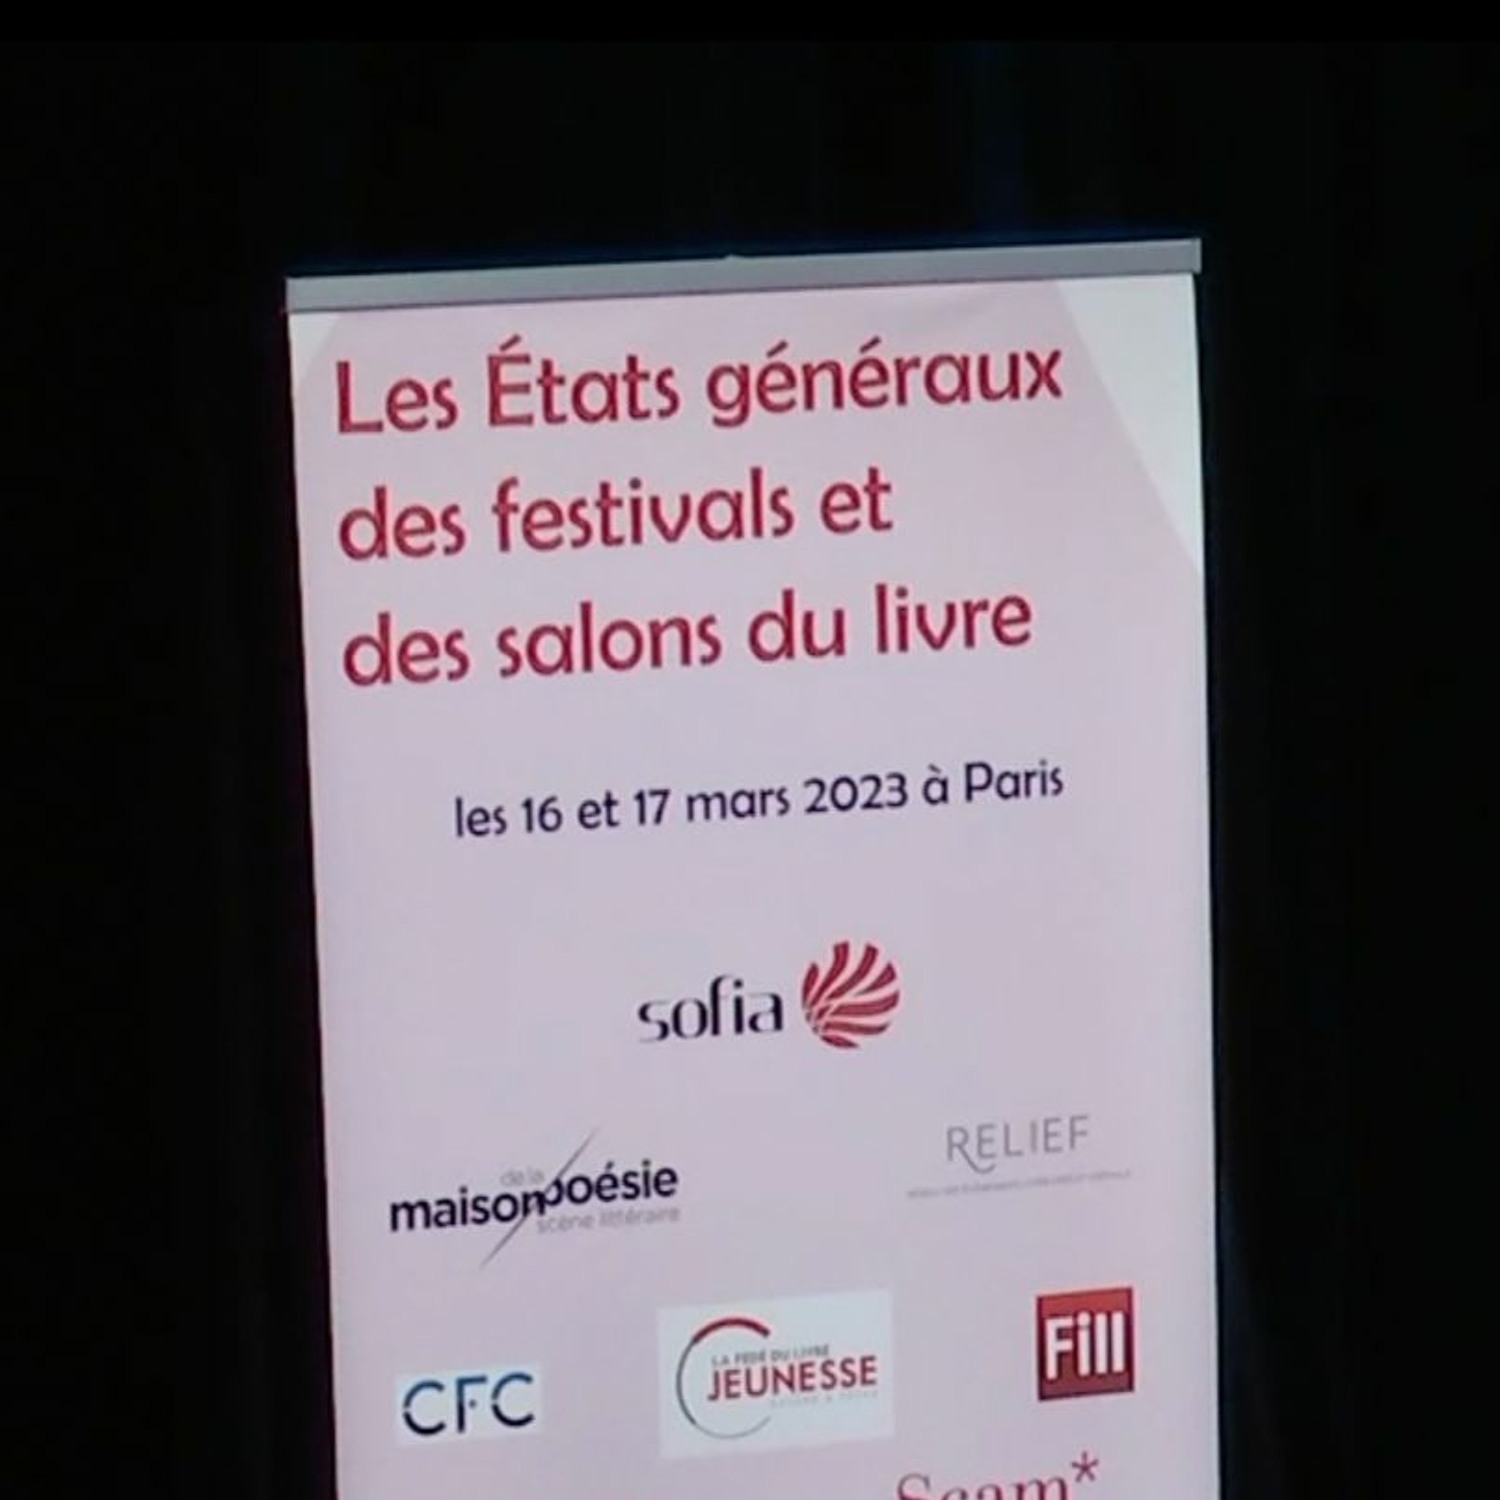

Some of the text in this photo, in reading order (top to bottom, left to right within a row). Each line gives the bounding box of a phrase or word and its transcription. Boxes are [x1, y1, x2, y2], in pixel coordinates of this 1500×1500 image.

[336, 335, 1063, 434] Les États généraux
[339, 466, 894, 561] des festivals et
[343, 583, 1032, 687] des salons du livre
[455, 758, 1064, 838] les 16 et 17 mars 2023 à Paris
[638, 974, 784, 1043] sofia
[946, 1114, 1090, 1175] RELIEF
[389, 1185, 546, 1232] maison
[707, 1355, 877, 1402] JEUNESSE
[1045, 1310, 1125, 1380] Fill
[402, 1371, 535, 1435] CFC
